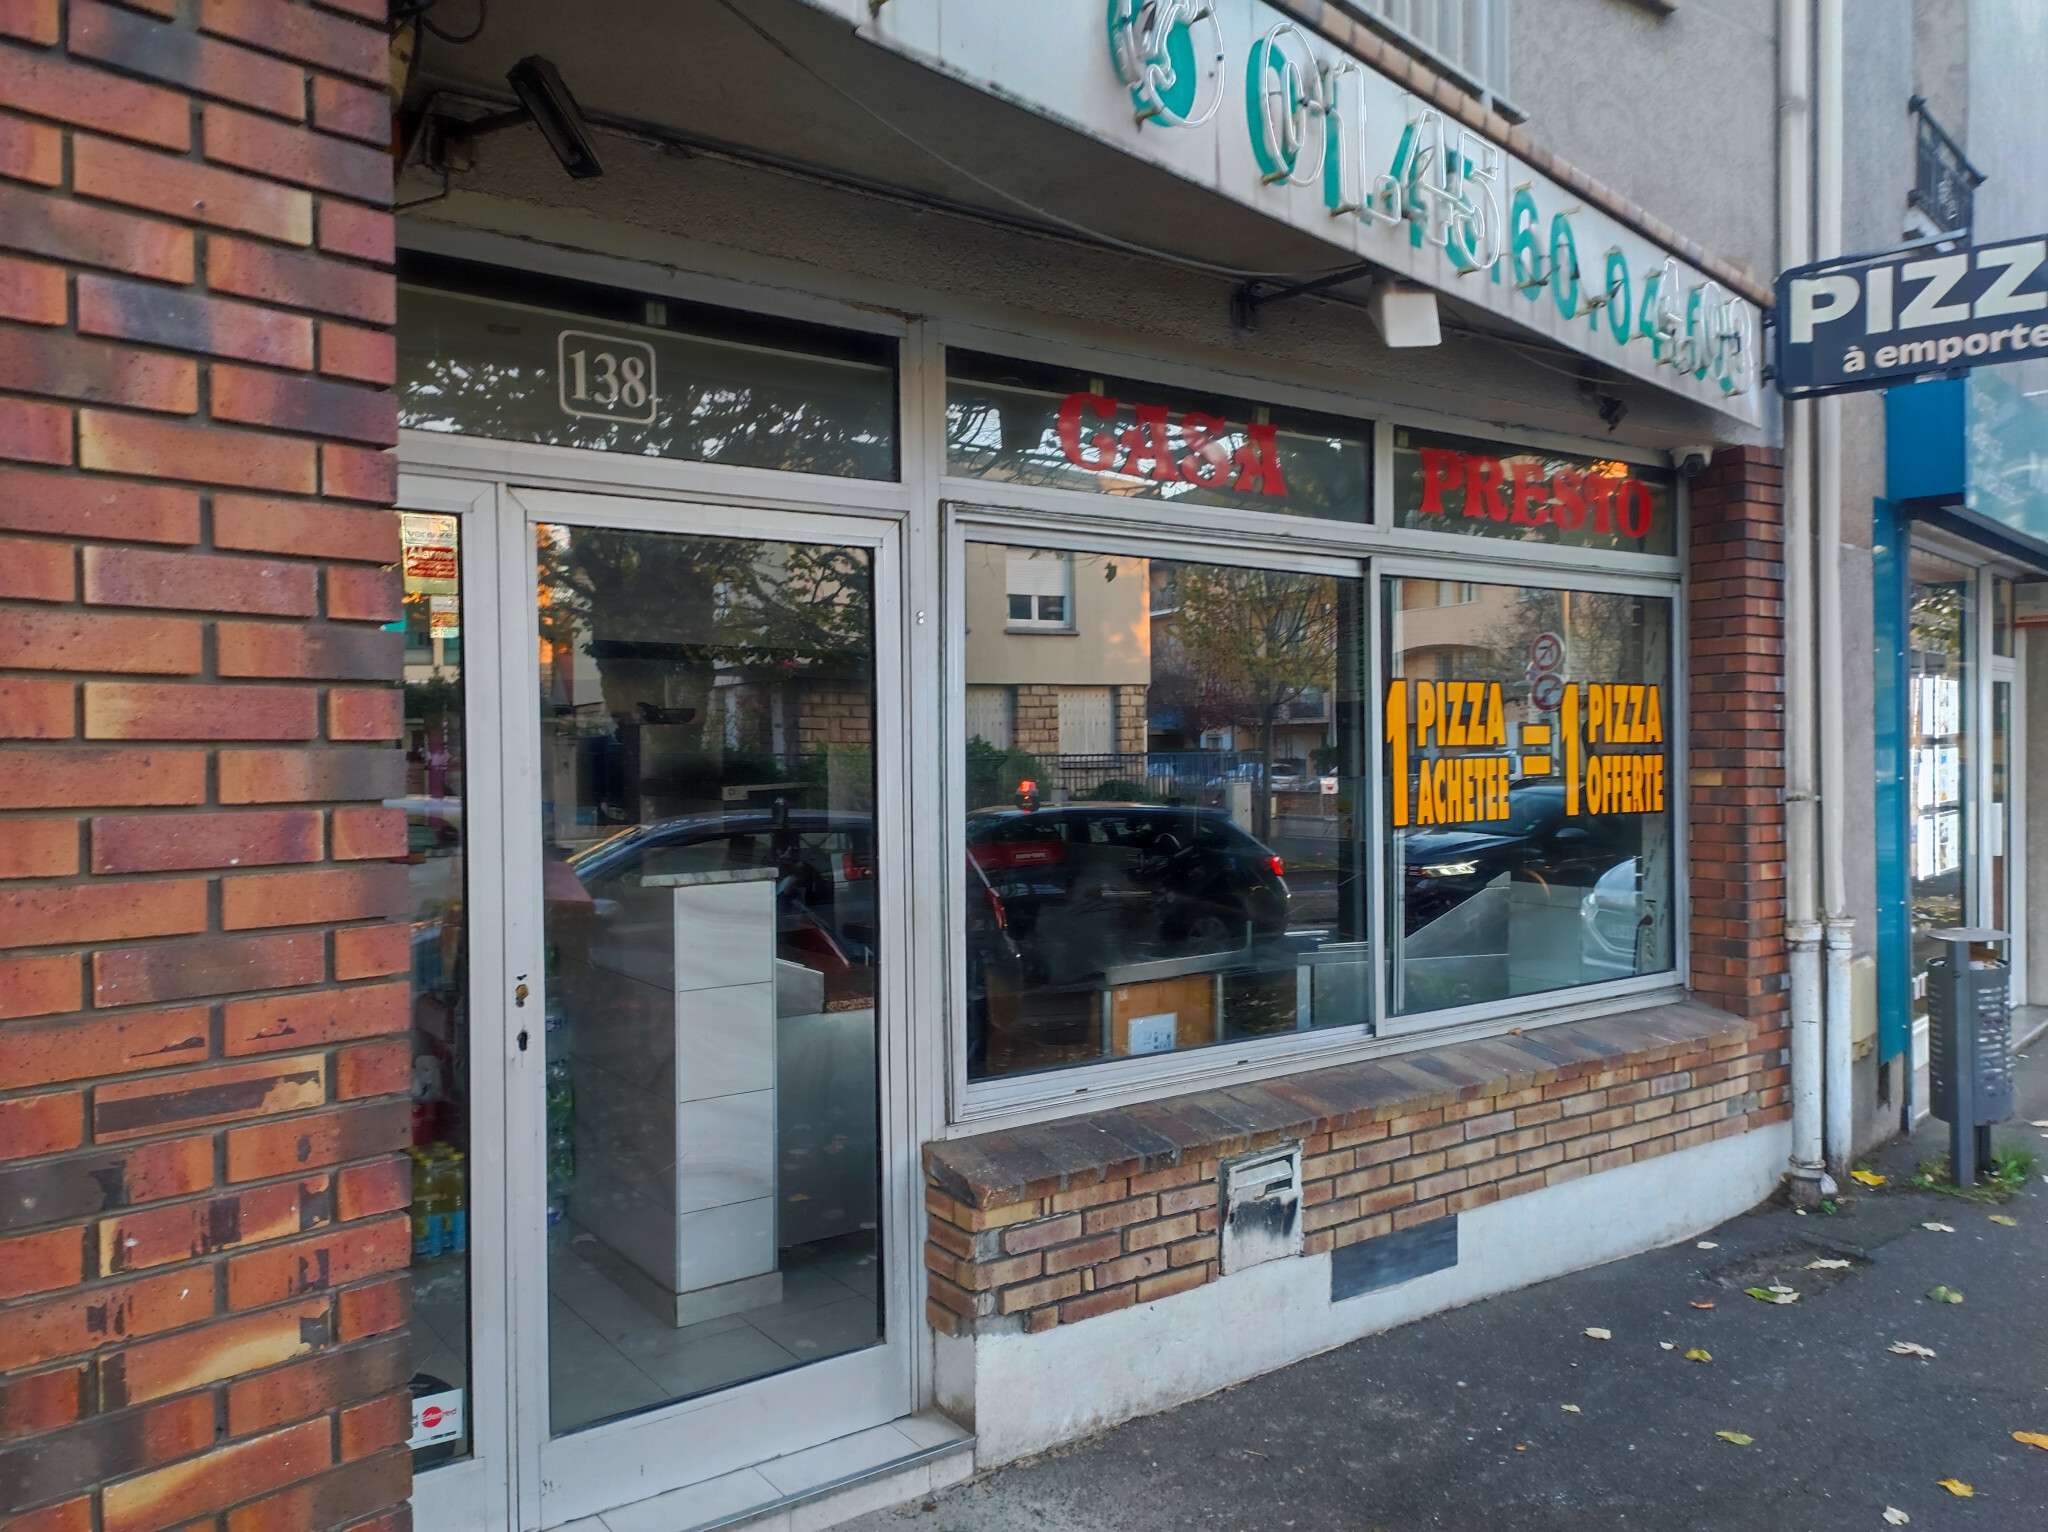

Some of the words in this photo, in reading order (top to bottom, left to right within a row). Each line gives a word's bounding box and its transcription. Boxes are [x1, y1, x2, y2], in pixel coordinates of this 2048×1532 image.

[1789, 241, 2048, 343] PIZZ
[569, 350, 646, 407] 138
[1843, 345, 1865, 373] à
[1874, 323, 2048, 368] emporte
[1420, 447, 1653, 538] PRESTO
[1386, 678, 1408, 827] 1
[1416, 679, 1507, 747] PIZZA
[1560, 682, 1580, 816] 1
[1588, 683, 1663, 744] PIZZA
[1416, 756, 1511, 825] ACHETEE
[1586, 754, 1665, 816] OFFERTE
